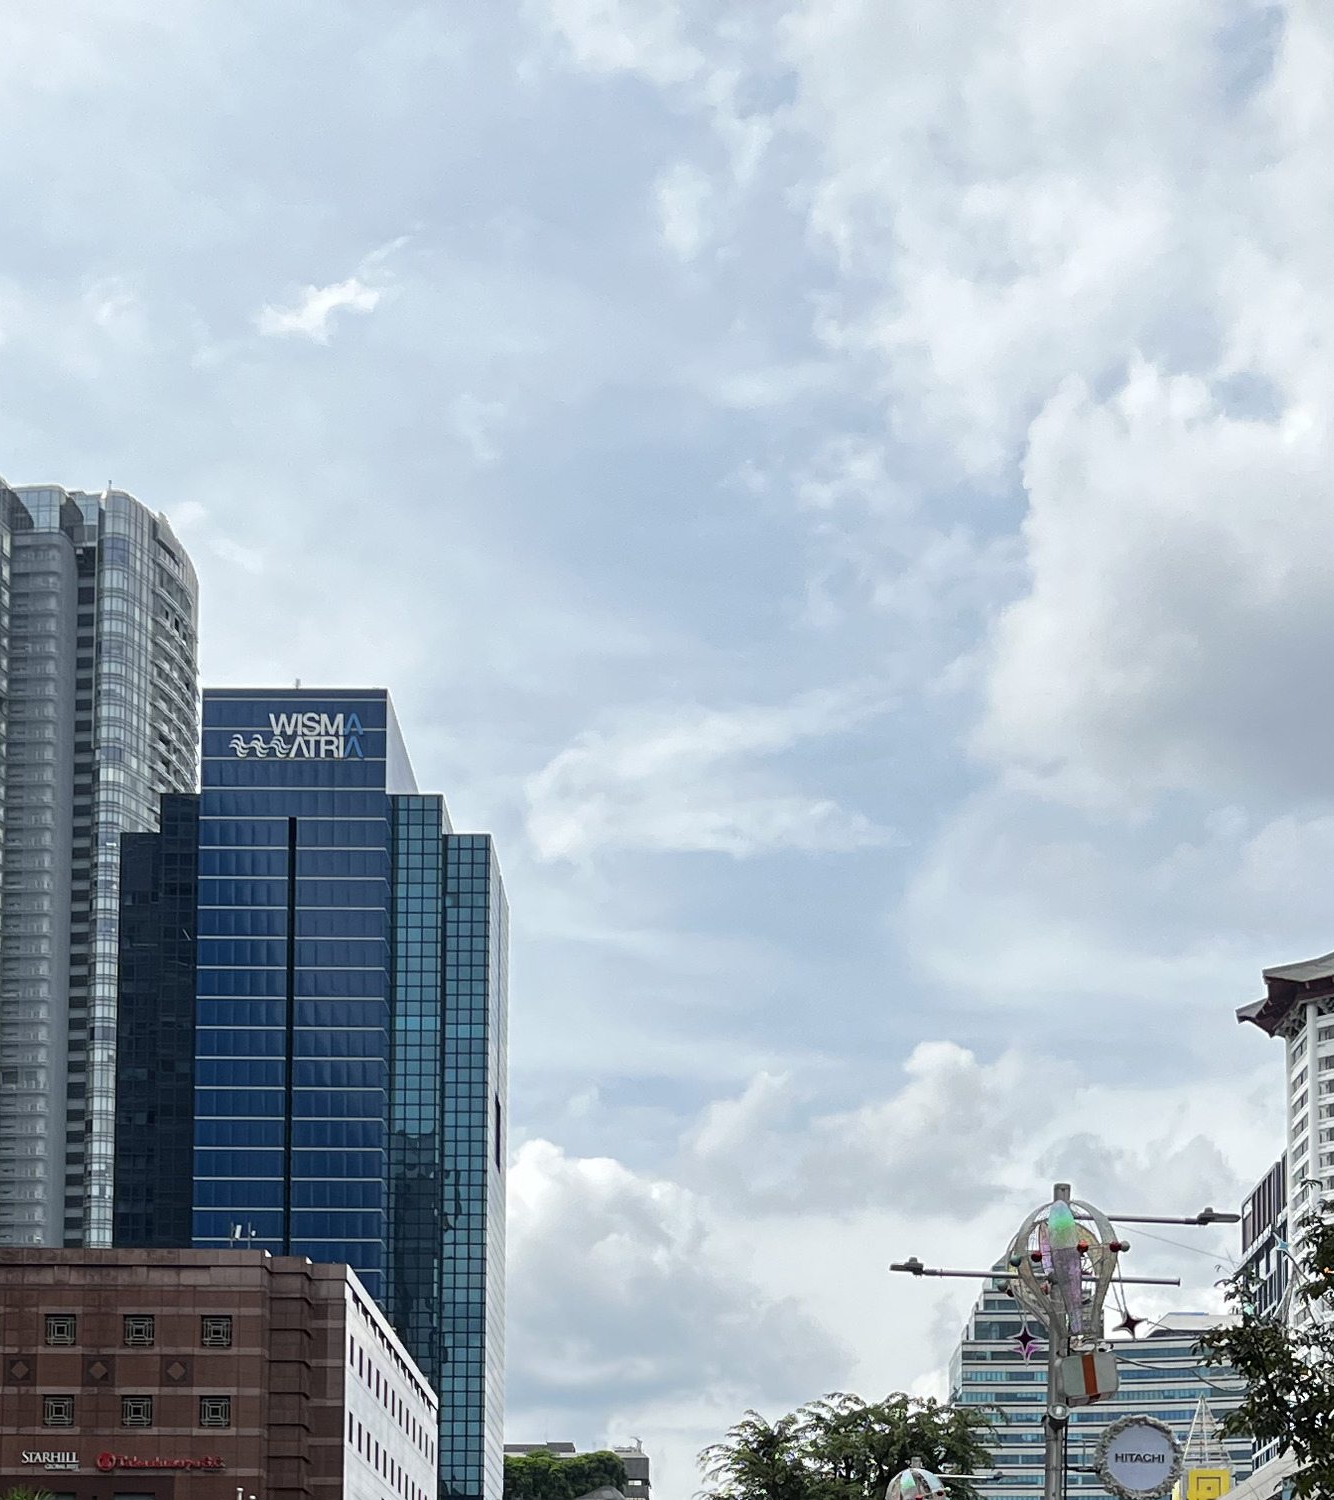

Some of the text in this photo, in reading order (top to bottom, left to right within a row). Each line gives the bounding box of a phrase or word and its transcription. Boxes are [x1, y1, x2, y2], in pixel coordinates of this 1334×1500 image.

[269, 712, 364, 736] WISMA
[289, 736, 364, 758] ATRIA
[21, 1451, 79, 1463] STARHILL
[1115, 1453, 1165, 1463] HITACHI
